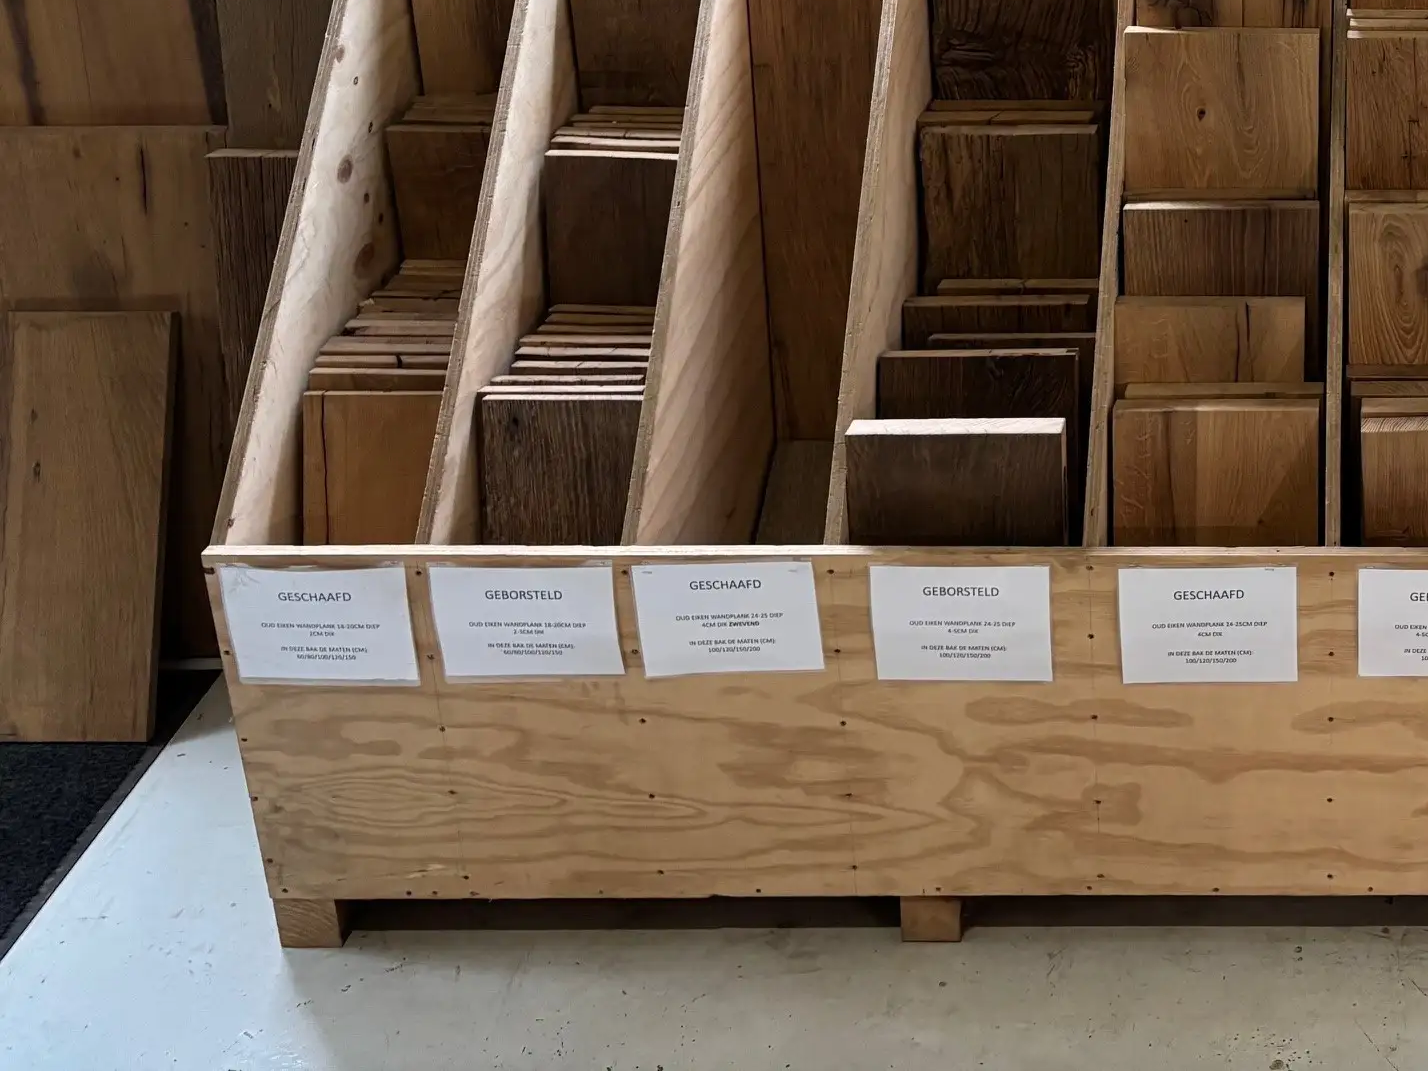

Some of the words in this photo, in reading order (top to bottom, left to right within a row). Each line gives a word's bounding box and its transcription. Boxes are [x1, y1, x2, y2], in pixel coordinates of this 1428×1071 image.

[689, 579, 761, 590] GESCHAAFD
[278, 592, 352, 602] GESCHAAFD
[485, 590, 562, 600] GEBORSTELD
[923, 587, 999, 597] GEBORSTELD
[1174, 590, 1244, 600] GESCHAAFD
